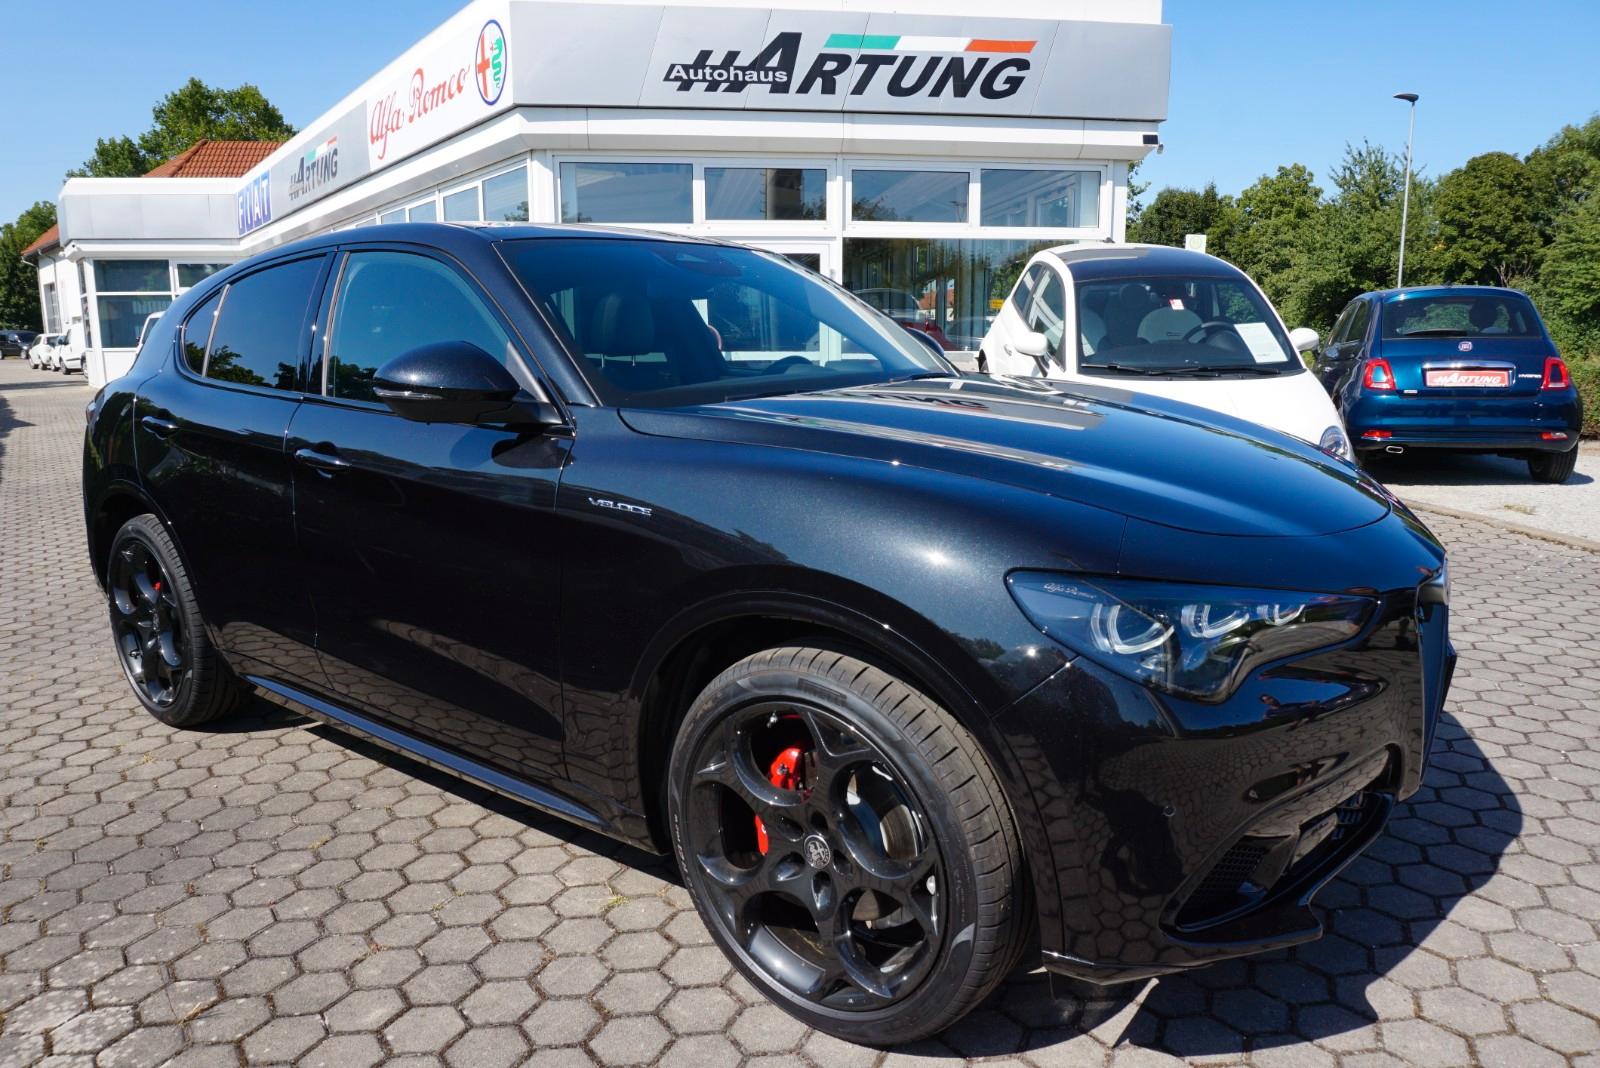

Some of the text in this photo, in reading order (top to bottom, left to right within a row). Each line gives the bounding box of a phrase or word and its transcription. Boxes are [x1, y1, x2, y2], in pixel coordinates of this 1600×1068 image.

[668, 64, 788, 82] Autohaus
[370, 65, 470, 160] Alfa Romeo
[239, 178, 270, 230] FIAT
